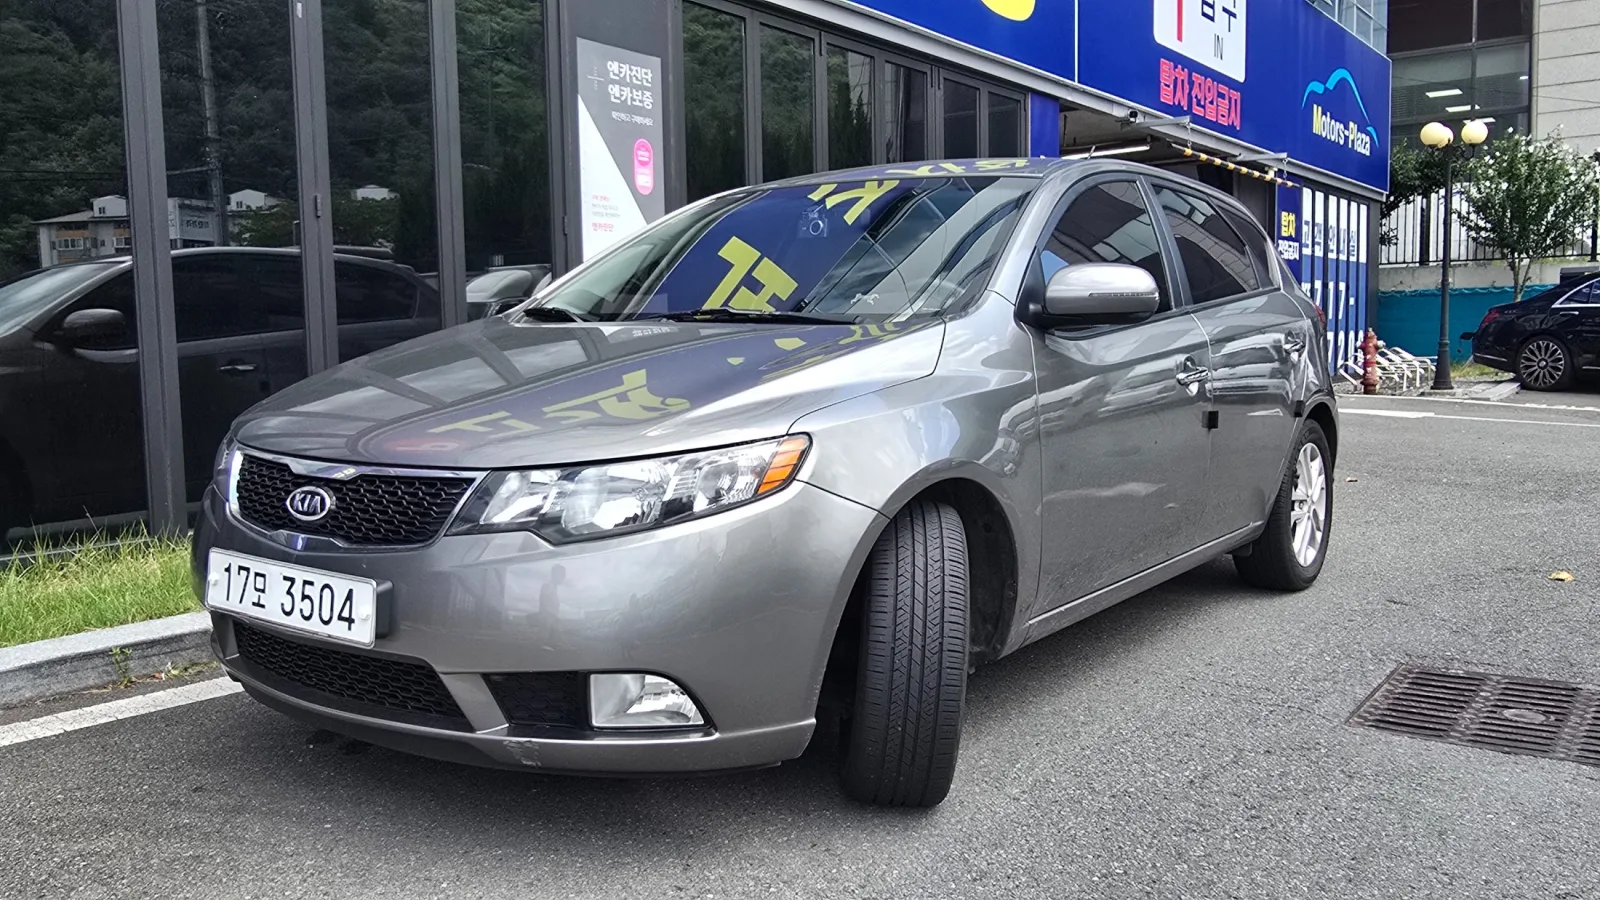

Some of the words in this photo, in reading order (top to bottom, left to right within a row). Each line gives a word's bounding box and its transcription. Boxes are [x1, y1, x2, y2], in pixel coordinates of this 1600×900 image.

[1213, 33, 1224, 61] IN
[606, 60, 653, 87] 엔카진단
[607, 83, 654, 110] 엔카보증
[1159, 57, 1190, 111] 탑차
[1191, 71, 1241, 131] 진입금지
[1312, 103, 1371, 157] Motors-Plaza
[1281, 210, 1296, 238] 탑차
[292, 492, 322, 514] KIA
[223, 562, 267, 610] 17모
[280, 575, 356, 632] 3504
